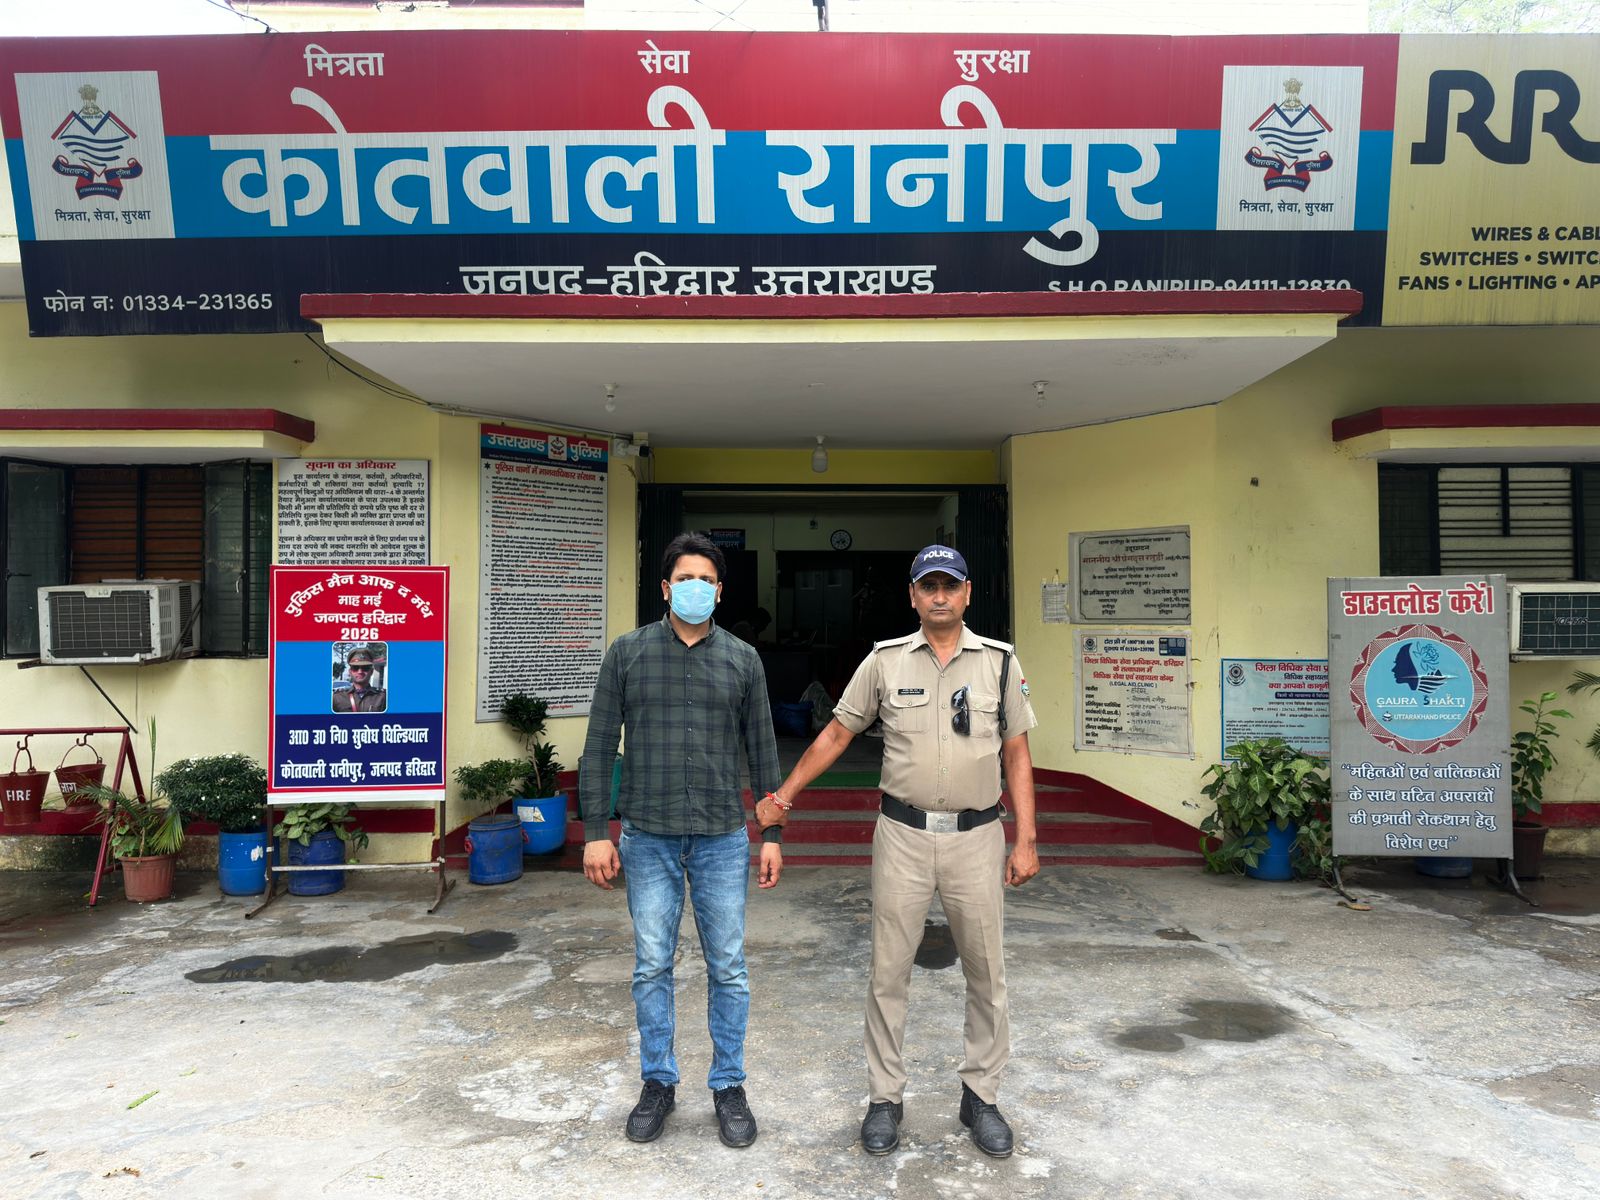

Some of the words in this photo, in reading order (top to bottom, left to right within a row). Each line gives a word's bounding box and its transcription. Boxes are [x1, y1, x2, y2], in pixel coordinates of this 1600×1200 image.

[303, 44, 385, 77] मित्रता
[638, 40, 690, 73] सेवा
[954, 49, 1030, 82] सुरक्षा
[209, 85, 726, 226] कोतवाली
[766, 84, 1178, 266] रानीपुर
[55, 208, 90, 222] मित्रता,
[93, 207, 118, 222] सेवा,
[121, 210, 151, 224] सुरक्षा
[1239, 199, 1273, 215] मित्रता,
[1278, 199, 1301, 214] सेवा,
[1305, 202, 1334, 217] सुरक्षा
[1472, 227, 1532, 241] WIRES
[1537, 227, 1550, 241] &
[1419, 252, 1518, 266] SWITCHES
[752, 265, 937, 293] उत्तराखण्ड
[1398, 276, 1449, 290] FANS
[1469, 275, 1557, 290] LIGHTING
[43, 289, 85, 312] फोन
[123, 294, 272, 311] 01334-231365
[487, 432, 546, 452] उत्तराखण्ड
[569, 440, 603, 462] पुलिस
[306, 461, 334, 471] सूचना
[338, 461, 352, 470] का
[355, 459, 397, 470] अधिकार
[923, 550, 954, 562] POLICE
[284, 580, 324, 618] पुलिस
[326, 572, 354, 588] मैन
[358, 574, 396, 590] आफ
[398, 585, 411, 598] द
[411, 594, 434, 619] मंथ
[338, 595, 361, 606] माह
[363, 591, 383, 607] मई
[1342, 584, 1442, 614] डाउनलोड
[313, 613, 359, 624] जनपद
[362, 609, 407, 625] हरिद्वार
[341, 628, 379, 640] 2026
[1255, 662, 1276, 672] जिला
[1278, 662, 1303, 672] विधिक
[1305, 663, 1321, 672] सेवा
[1284, 672, 1303, 680] विधिक
[1282, 681, 1306, 689] आपको
[1376, 697, 1418, 705] GAURA
[1423, 695, 1466, 706] SHAKTI
[280, 760, 326, 779] कोतवाली
[329, 758, 366, 783] रानीपुर,
[370, 761, 402, 777] जनपद
[405, 757, 436, 777] हरिद्वार
[1408, 763, 1430, 780] एवं
[1433, 763, 1502, 779] बालिकाओं
[6, 789, 32, 802] FIRE
[1348, 785, 1363, 802] के
[1366, 789, 1396, 802] साथ
[1400, 787, 1436, 803] घटित
[1439, 787, 1495, 803] अपराधों
[1348, 809, 1367, 826] की
[1370, 810, 1412, 827] प्रभावी
[1416, 810, 1470, 826] रोकथाम
[1474, 810, 1497, 831] हेतु
[1385, 833, 1423, 849] विशेष
